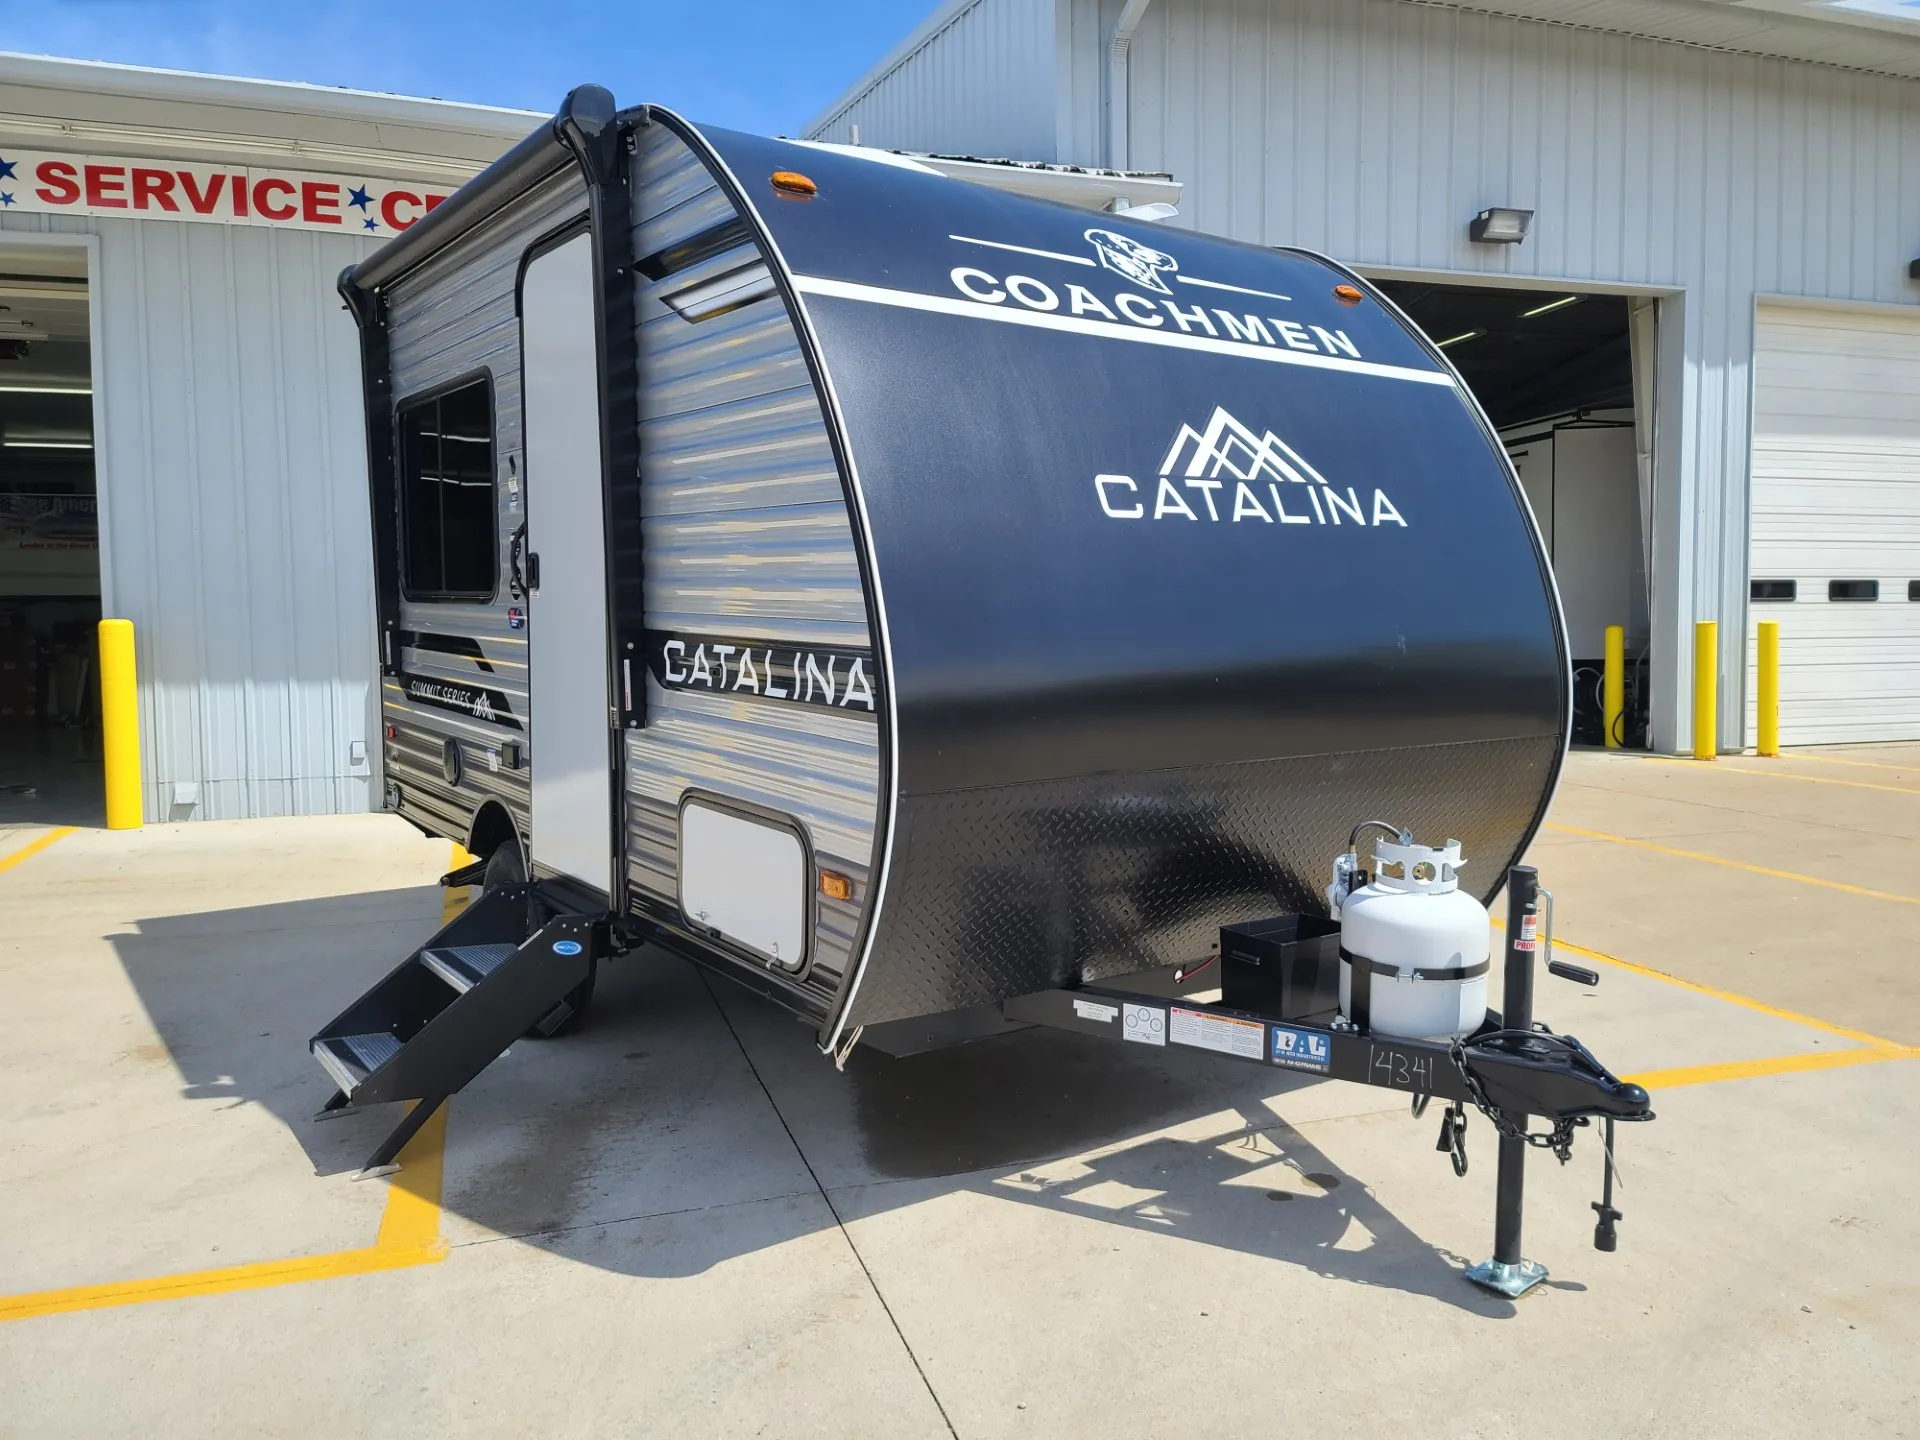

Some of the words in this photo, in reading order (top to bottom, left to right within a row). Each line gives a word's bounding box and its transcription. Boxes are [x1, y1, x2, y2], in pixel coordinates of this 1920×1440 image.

[35, 161, 343, 225] SERVICE
[380, 190, 449, 232] C
[949, 266, 1363, 359] COACHMEN
[1094, 473, 1409, 528] CATALINA
[411, 680, 442, 698] SUMMIT
[442, 686, 472, 708] SERIES
[663, 639, 875, 711] CATALINA
[1368, 1044, 1433, 1089] 14341
